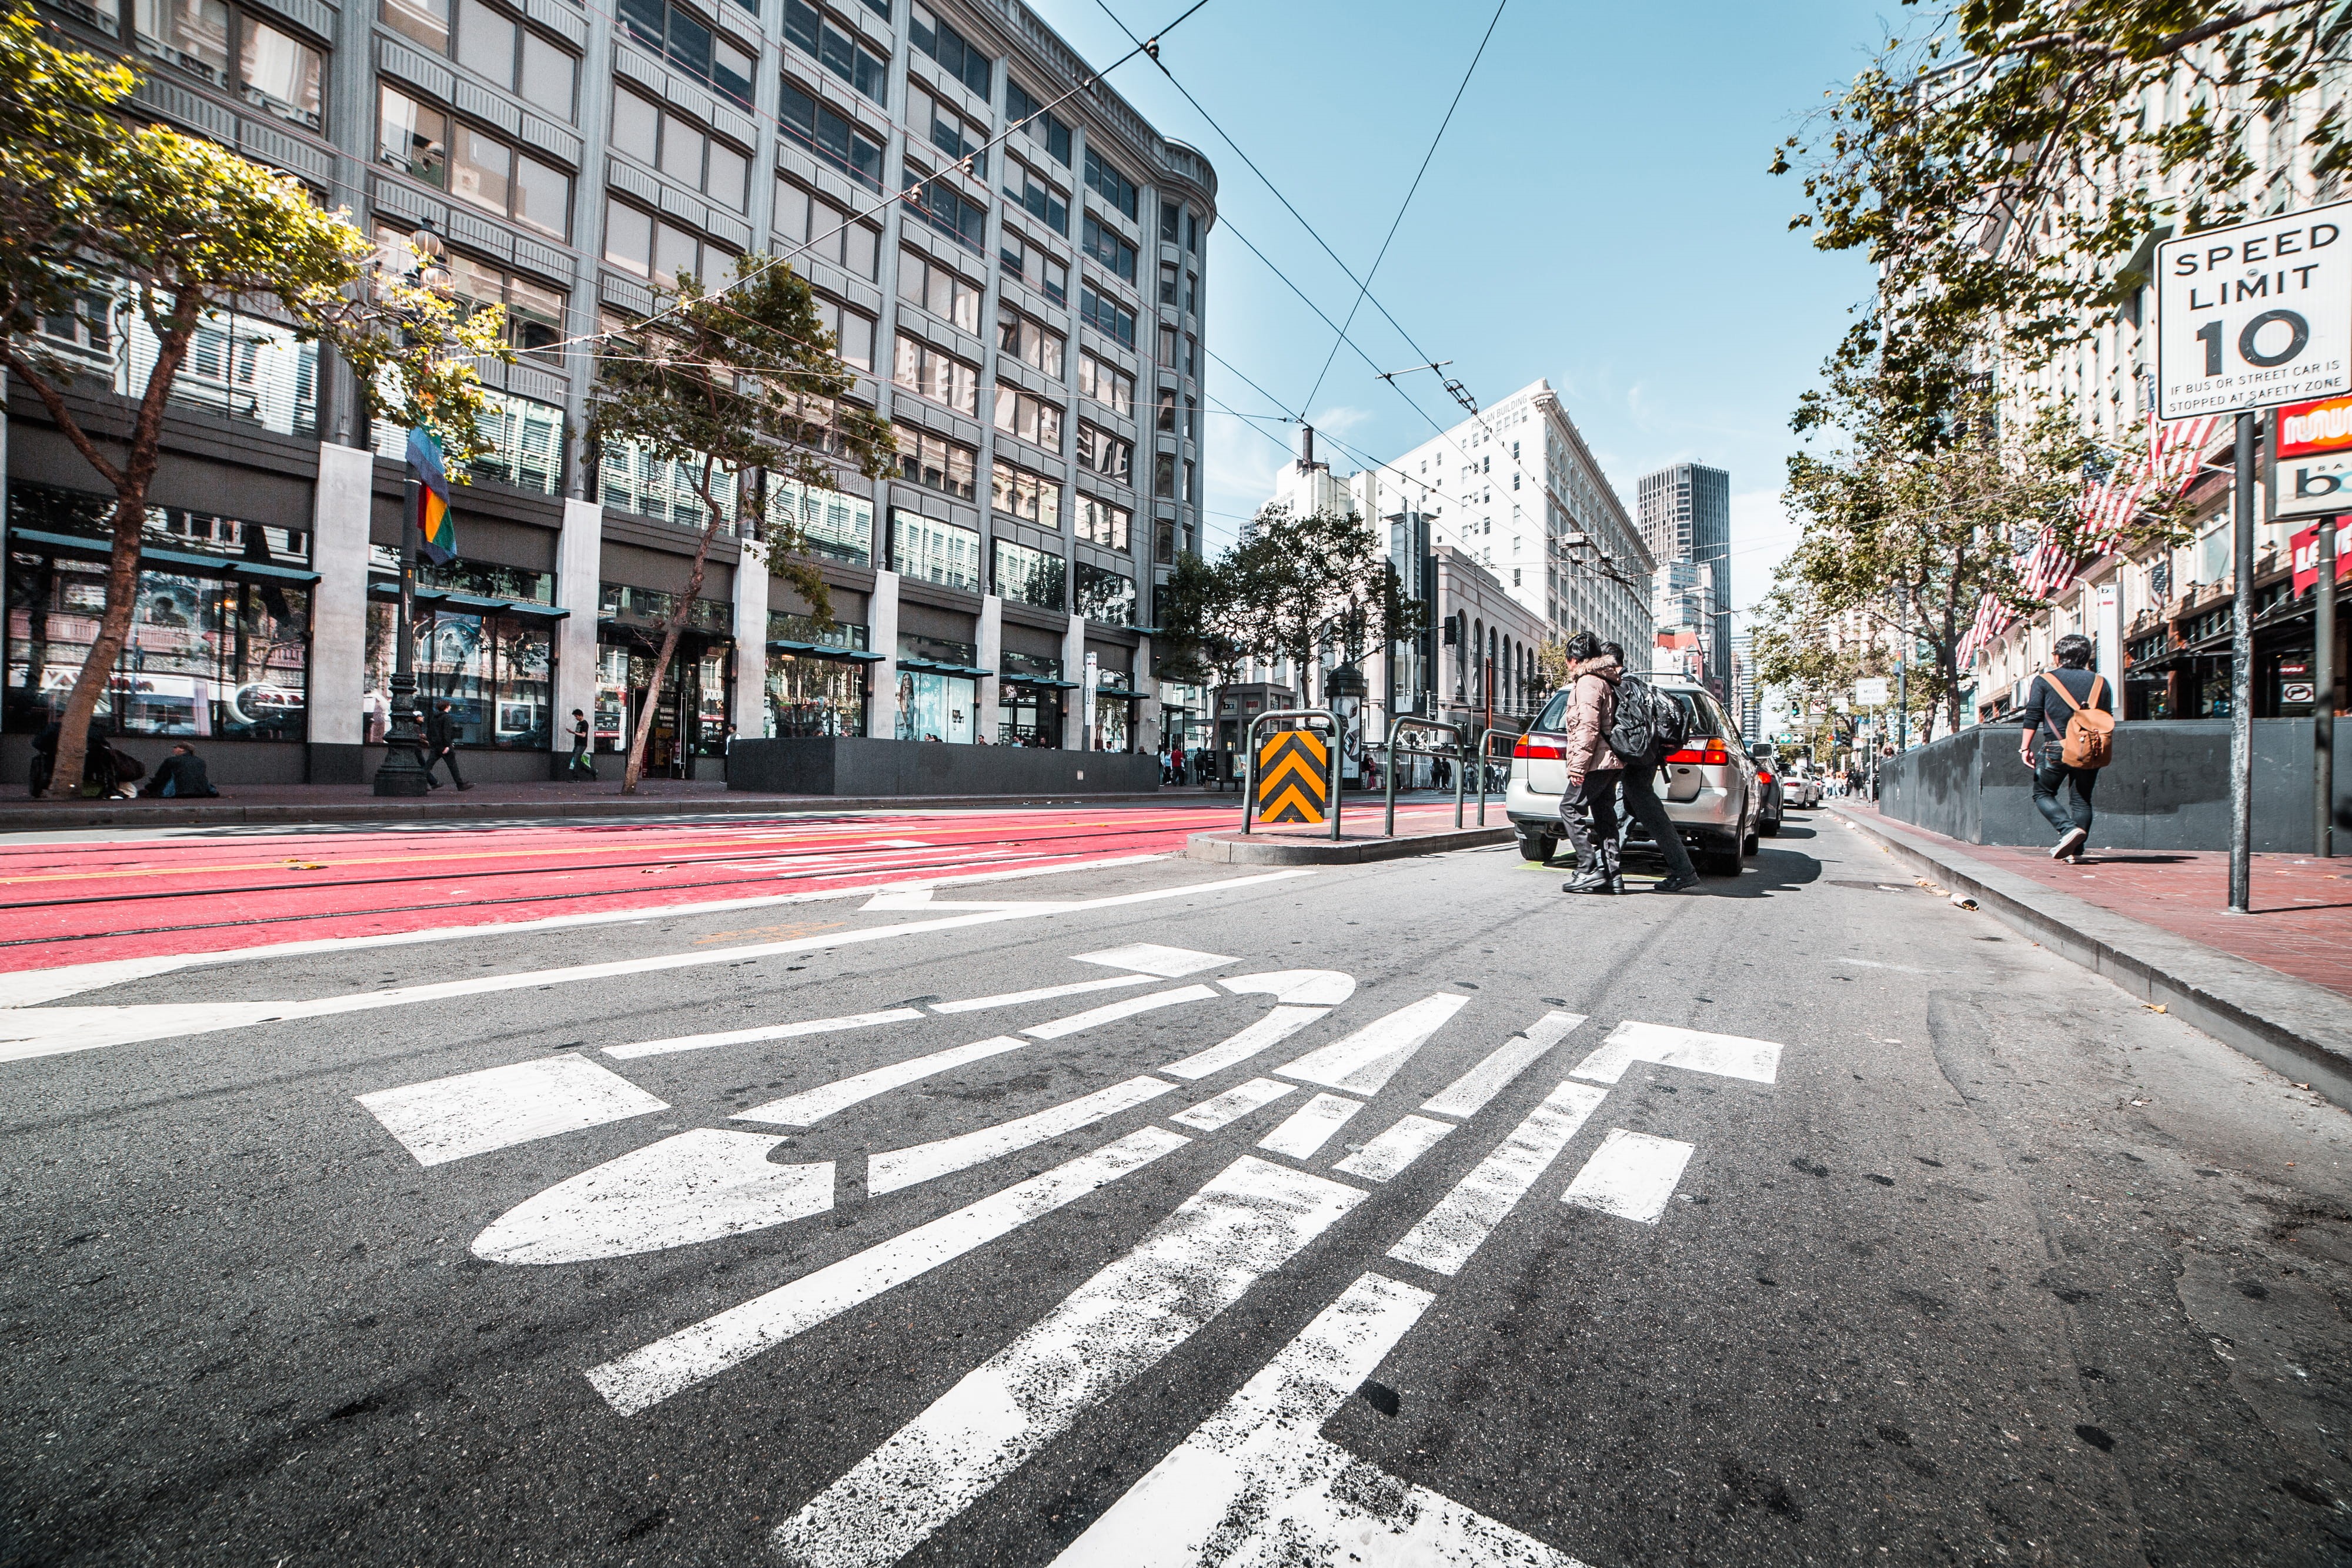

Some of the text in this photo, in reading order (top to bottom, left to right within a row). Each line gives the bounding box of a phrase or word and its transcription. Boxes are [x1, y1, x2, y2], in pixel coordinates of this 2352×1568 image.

[2174, 224, 2340, 276] SPEED
[2190, 263, 2320, 310] LIMIT
[2197, 309, 2309, 377] 10
[2169, 377, 2343, 412] STOPPED AT SAFETY ZONE
[2171, 360, 2340, 396] IF BUS OR STREET CAR IS
[1496, 394, 1527, 418] BUILDING
[356, 942, 1782, 1568] ZONE
